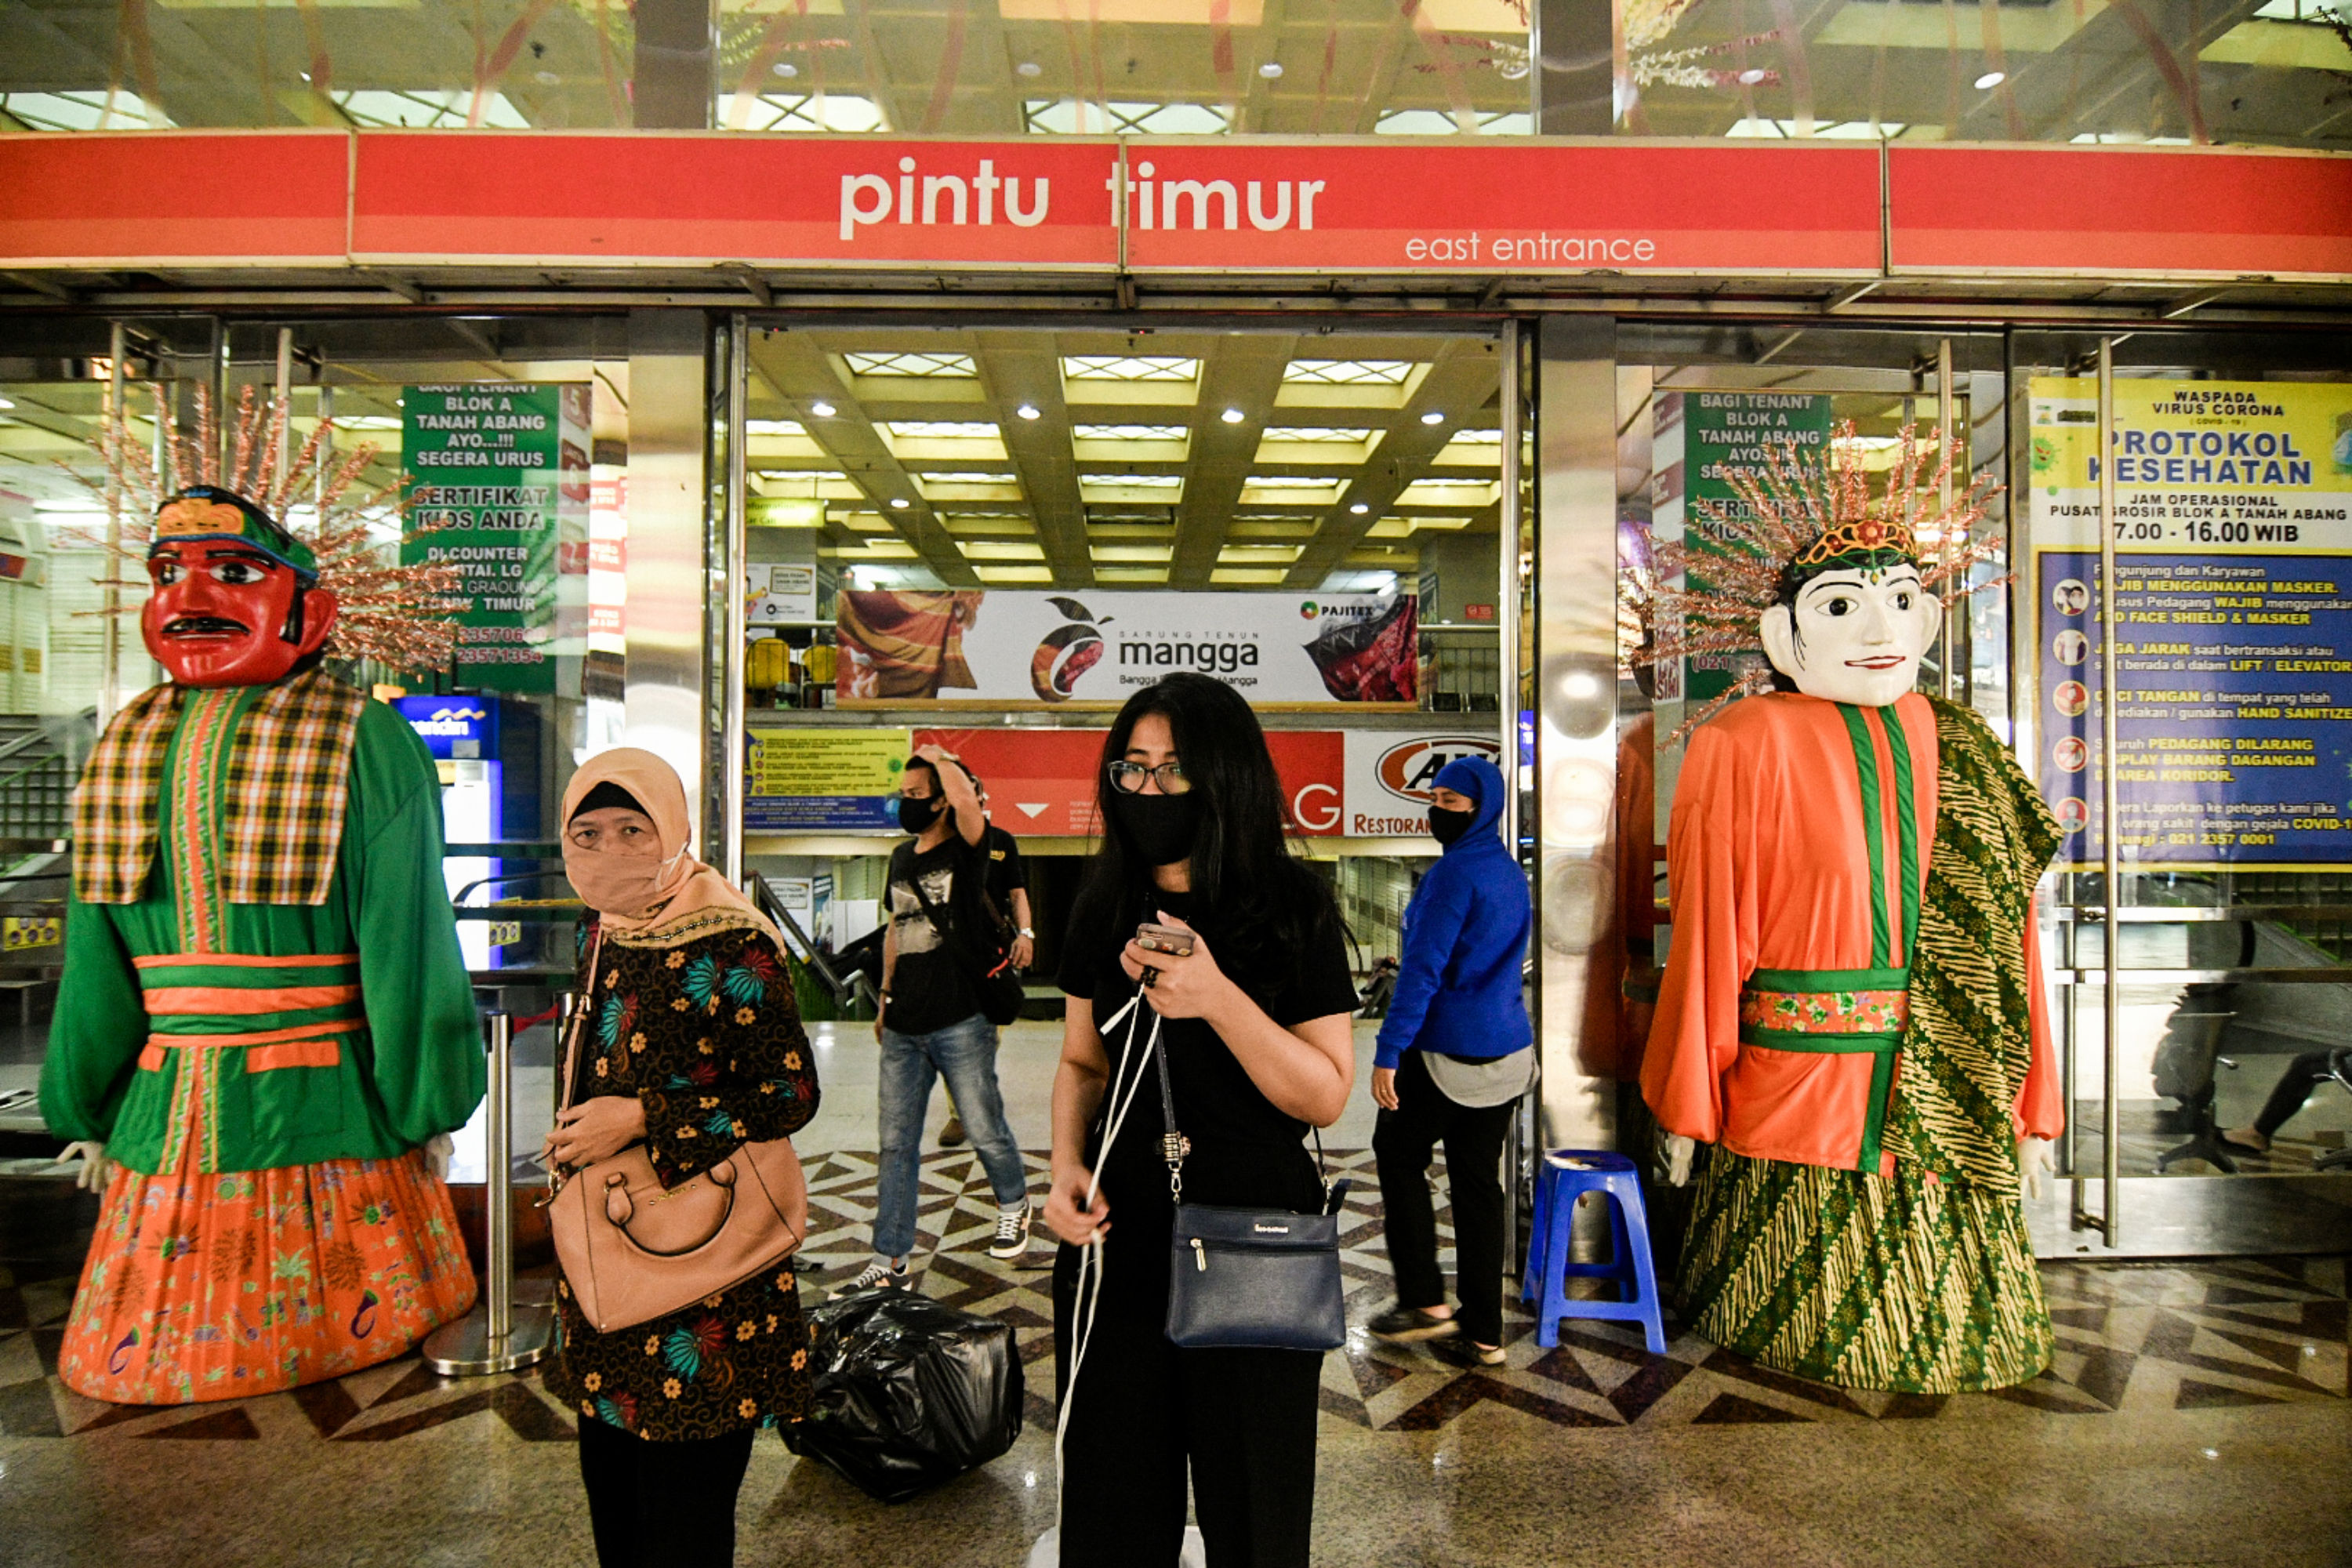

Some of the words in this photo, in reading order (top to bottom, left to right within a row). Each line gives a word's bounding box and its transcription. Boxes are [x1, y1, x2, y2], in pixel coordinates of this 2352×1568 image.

[840, 158, 1049, 241] pintu
[1107, 162, 1325, 231] timur
[1406, 234, 1479, 262] east
[1490, 231, 1655, 262] entrance
[1700, 395, 1740, 408] BAGI
[1747, 396, 1813, 409] TENANT
[2174, 391, 2256, 403] WASPADA
[445, 397, 494, 411] BLOK
[500, 397, 512, 411] A
[2153, 403, 2205, 415] VIRUS
[2212, 404, 2285, 416] CORONA
[416, 415, 477, 429] TANAH
[482, 416, 546, 430] ABANG
[1726, 412, 1771, 426] BLOK
[1777, 414, 1788, 426] A
[1699, 430, 1755, 443] TANAH
[1762, 430, 1820, 445] ABANG
[416, 452, 488, 466] SEGERA
[495, 452, 544, 466] URUS
[2130, 495, 2161, 505] JAM
[2169, 495, 2278, 506] OPERASIONAL
[2050, 506, 2100, 516] PUSAT
[2172, 507, 2213, 517] BLOK
[2220, 508, 2230, 517] A
[2236, 508, 2287, 519] TANAH
[2292, 510, 2347, 520] ABANG
[2185, 522, 2249, 542] 16.00
[2255, 525, 2299, 541] WIB
[449, 547, 528, 561] COUNTER
[501, 564, 522, 577] LG
[2175, 565, 2198, 576] dan
[2202, 566, 2265, 578] Karyawan
[2147, 580, 2267, 592] MENGGUNAKAN
[2271, 582, 2339, 593] MASKER.
[483, 597, 535, 610] TIMUR
[2147, 597, 2211, 610] Pedagang
[2214, 597, 2263, 608] WAJIB
[1322, 606, 1372, 616] PAJITEX
[2094, 612, 2125, 623] AD
[2129, 612, 2167, 623] FACE
[2172, 612, 2227, 623] SHIELD
[2231, 613, 2243, 623] &
[2247, 613, 2310, 624] MASKER
[1119, 630, 1192, 639] SARUNG
[1204, 630, 1258, 639] TENUN
[2095, 642, 2135, 655] JGA
[2139, 644, 2190, 655] JARAK
[2194, 644, 2221, 655] saat
[2223, 645, 2303, 656] bertransaksi
[2306, 647, 2333, 656] atau
[1120, 642, 1258, 673] mangga
[2125, 659, 2169, 670] berada
[2172, 660, 2185, 670] di
[2188, 660, 2227, 670] dalam
[2230, 660, 2263, 671] LIFT
[2095, 691, 2132, 702] CCI
[2136, 691, 2201, 702] TANGAN
[2202, 691, 2216, 702] di
[2218, 692, 2263, 705] tempat
[2265, 694, 2296, 705] yang
[2299, 693, 2331, 703] telah
[2179, 707, 2234, 720] gunakan
[2237, 708, 2280, 719] HAND
[2148, 739, 2231, 750] PEDAGANG
[2236, 739, 2314, 750] DILARANG
[2163, 754, 2227, 766] BARANG
[2231, 755, 2316, 767] DAGANGAN
[2117, 771, 2157, 782] AREA
[2160, 771, 2235, 782] KORIDOR.
[2143, 802, 2205, 815] Laporkan
[2207, 802, 2223, 813] ke
[2226, 804, 2276, 816] petugas
[2279, 803, 2310, 814] kami
[2312, 803, 2336, 815] jika
[2122, 818, 2159, 831] orang
[2162, 818, 2194, 829] sakit
[2201, 818, 2248, 831] dengan
[2251, 818, 2289, 831] gejala
[2169, 833, 2194, 844] 021
[2200, 833, 2234, 844] 2357
[2241, 834, 2274, 844] 0001
